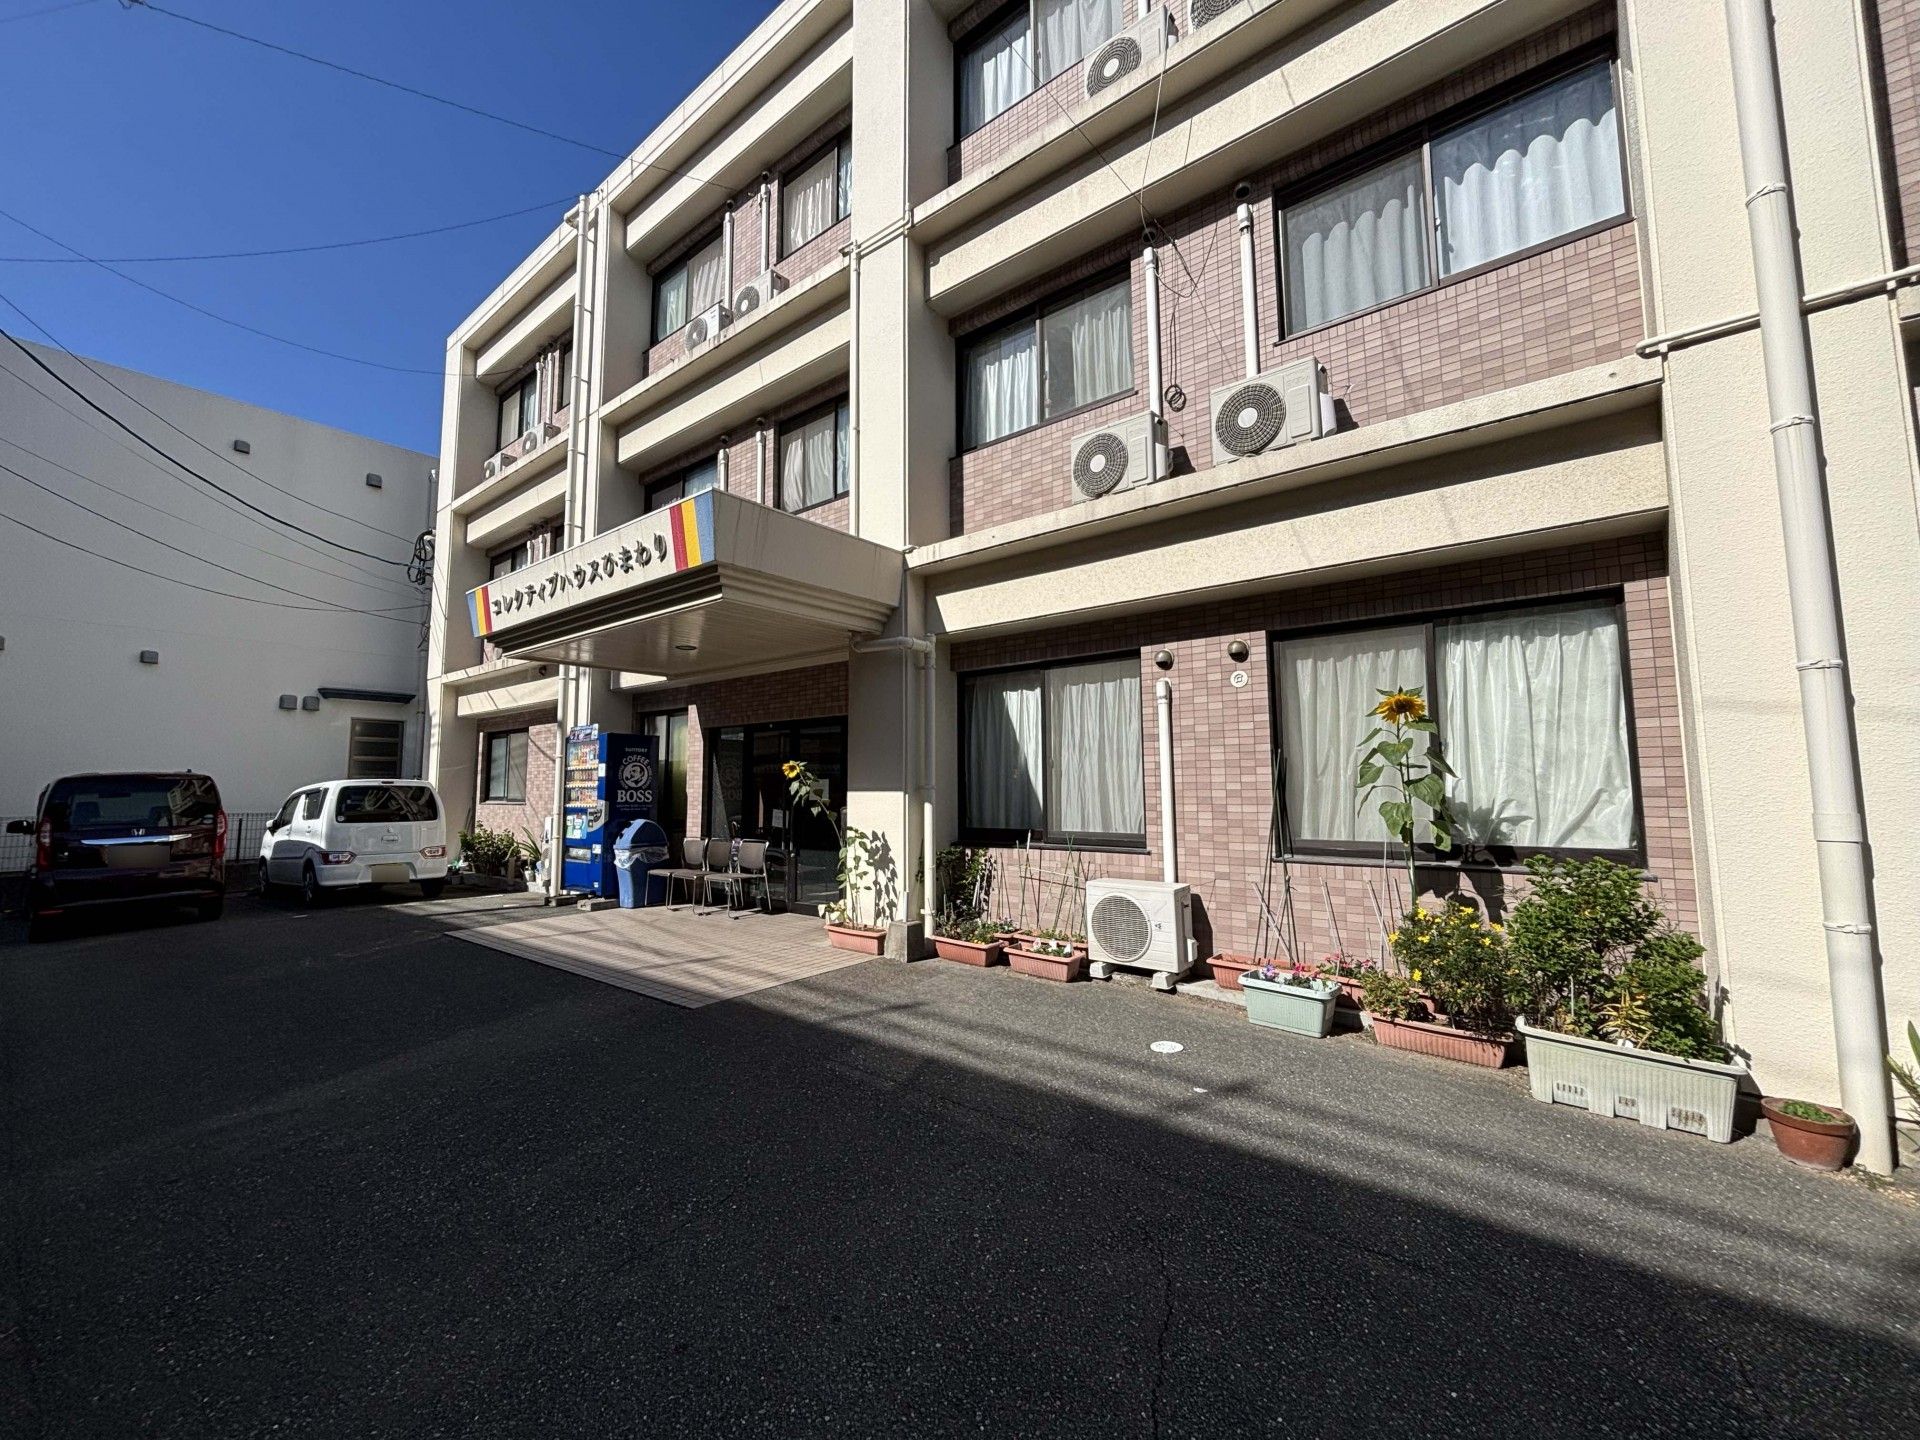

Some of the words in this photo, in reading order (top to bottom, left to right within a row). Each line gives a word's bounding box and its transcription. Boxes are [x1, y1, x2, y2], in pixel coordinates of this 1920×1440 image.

[491, 532, 668, 616] コレクティブハウスひまわり
[622, 754, 650, 767] COFFEE
[616, 789, 653, 803] BOSS
